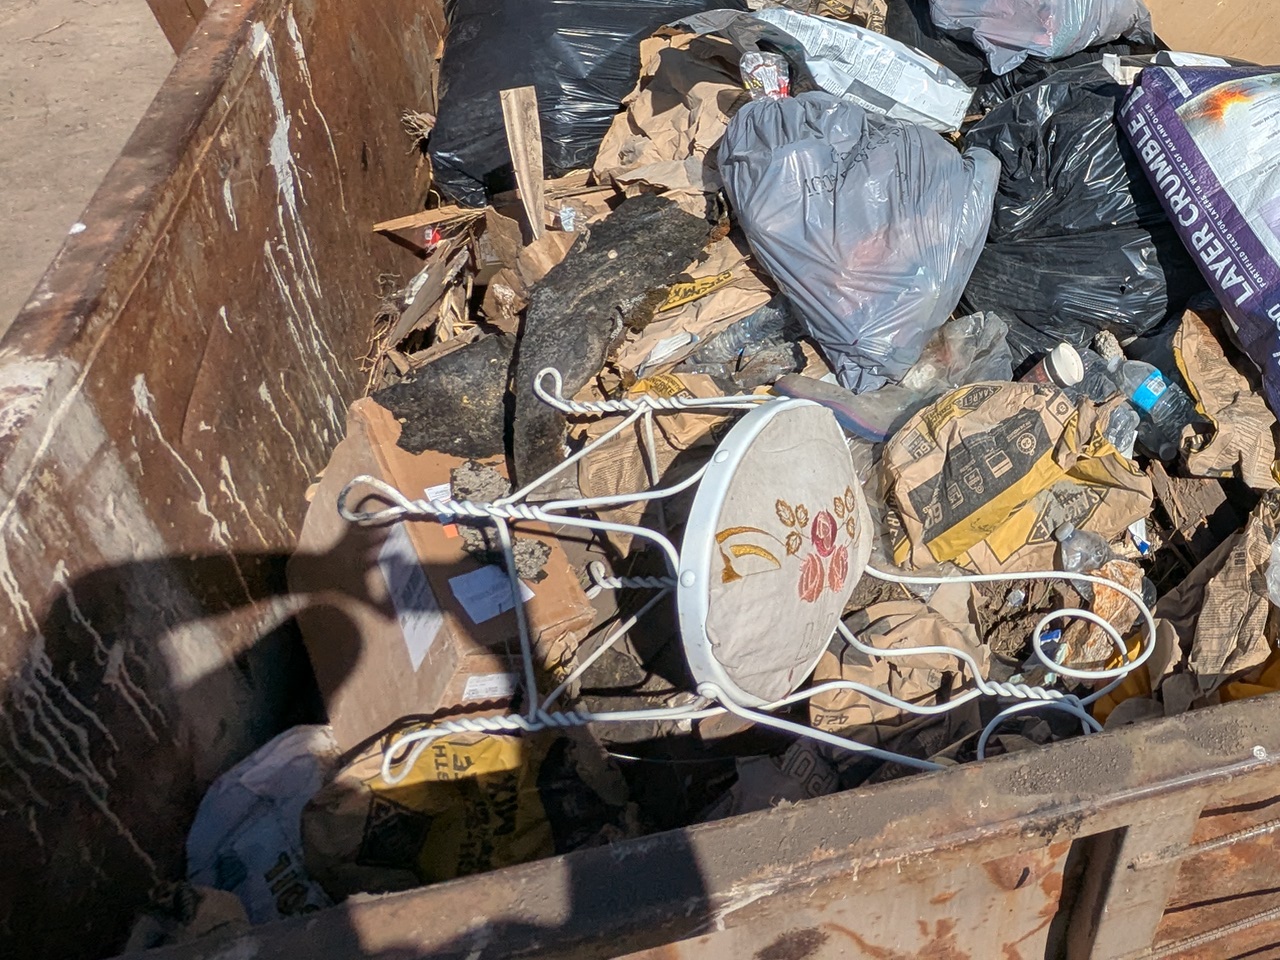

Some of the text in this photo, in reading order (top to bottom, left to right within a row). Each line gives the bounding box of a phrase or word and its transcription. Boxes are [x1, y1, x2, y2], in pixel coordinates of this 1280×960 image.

[1156, 123, 1168, 138] AND
[1164, 137, 1177, 152] AGE
[1174, 152, 1183, 162] OF
[1125, 112, 1200, 226] CRUMBLE
[1180, 162, 1198, 186] WEEKS
[1200, 194, 1220, 220] LAYERS
[1217, 219, 1229, 233] FOR
[1226, 232, 1241, 251] FEED
[1189, 223, 1254, 307] LAYER
[1239, 251, 1266, 288] FORTIFIED
